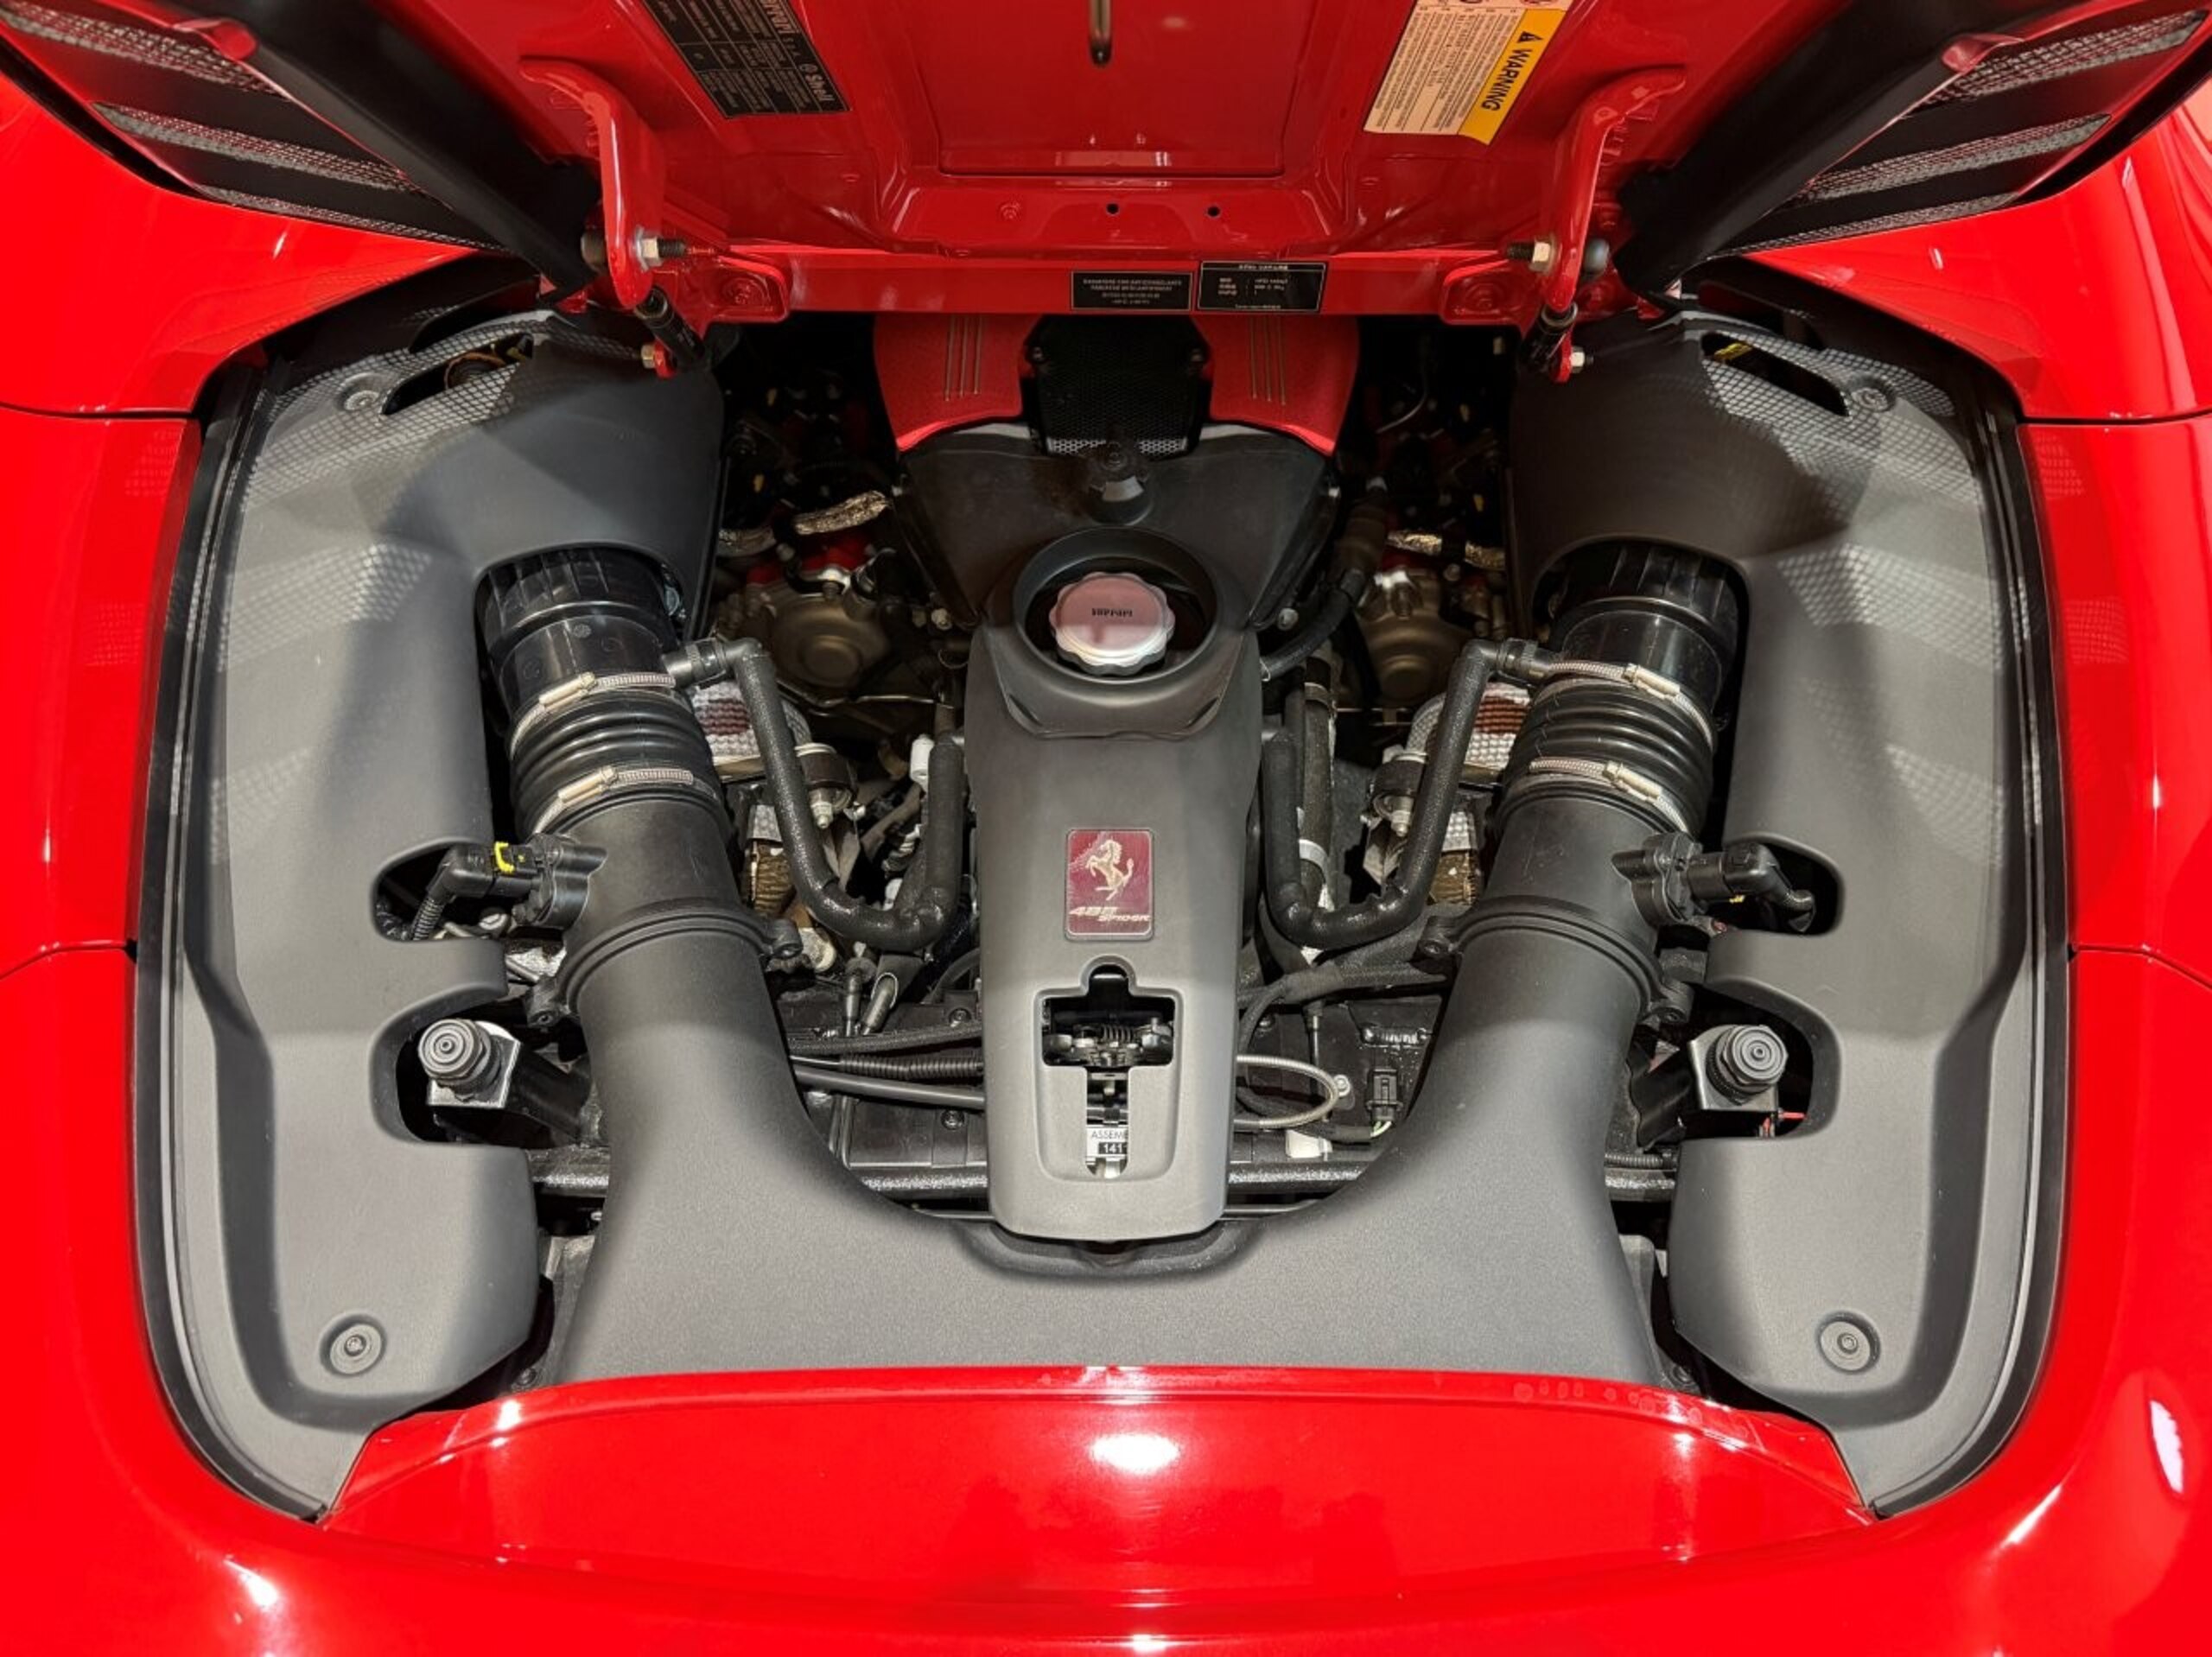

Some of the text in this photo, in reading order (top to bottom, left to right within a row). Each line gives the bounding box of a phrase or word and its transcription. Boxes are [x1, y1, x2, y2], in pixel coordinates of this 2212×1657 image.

[804, 73, 836, 102] Shell
[1480, 48, 1534, 111] WARNING
[1103, 1143, 1128, 1153] 141
